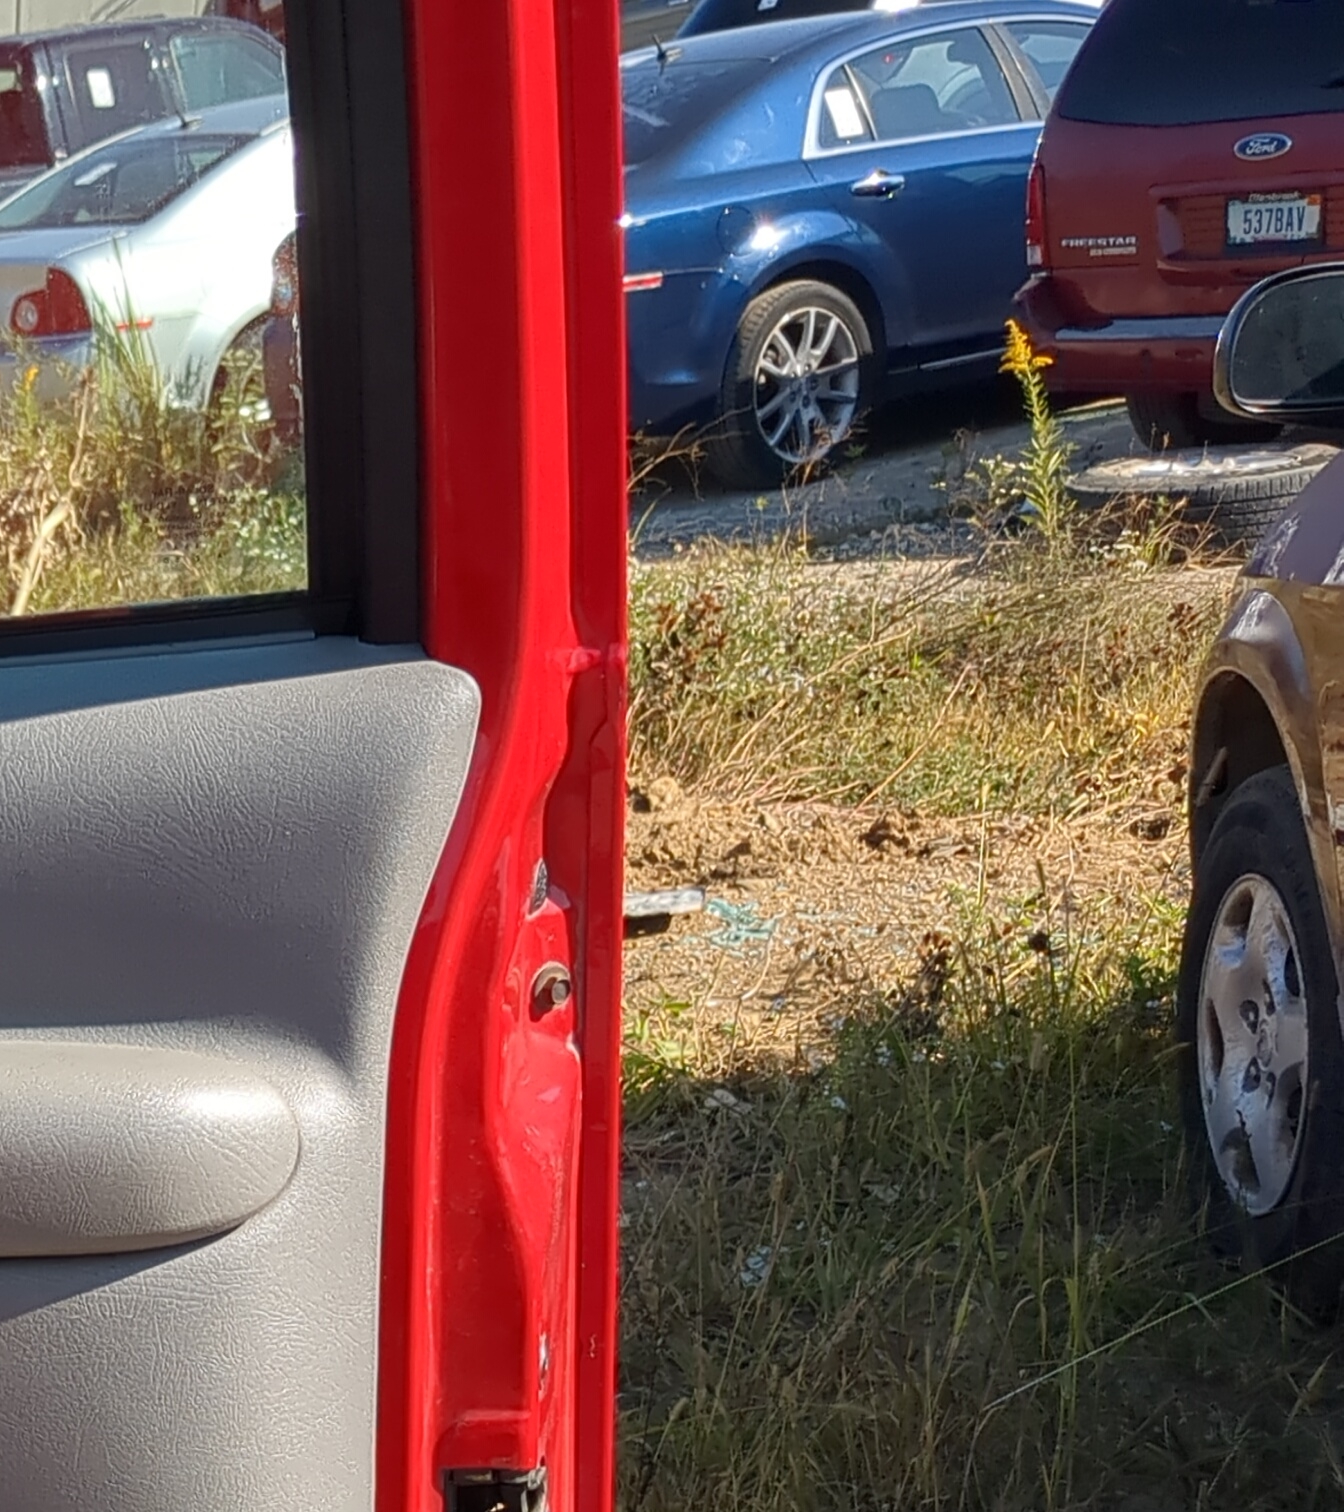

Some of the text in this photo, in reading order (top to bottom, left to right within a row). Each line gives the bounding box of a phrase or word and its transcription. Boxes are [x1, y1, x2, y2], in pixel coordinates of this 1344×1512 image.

[1245, 138, 1279, 156] Ford
[1243, 206, 1306, 235] 537BAV
[1061, 236, 1137, 248] FREESTAR
